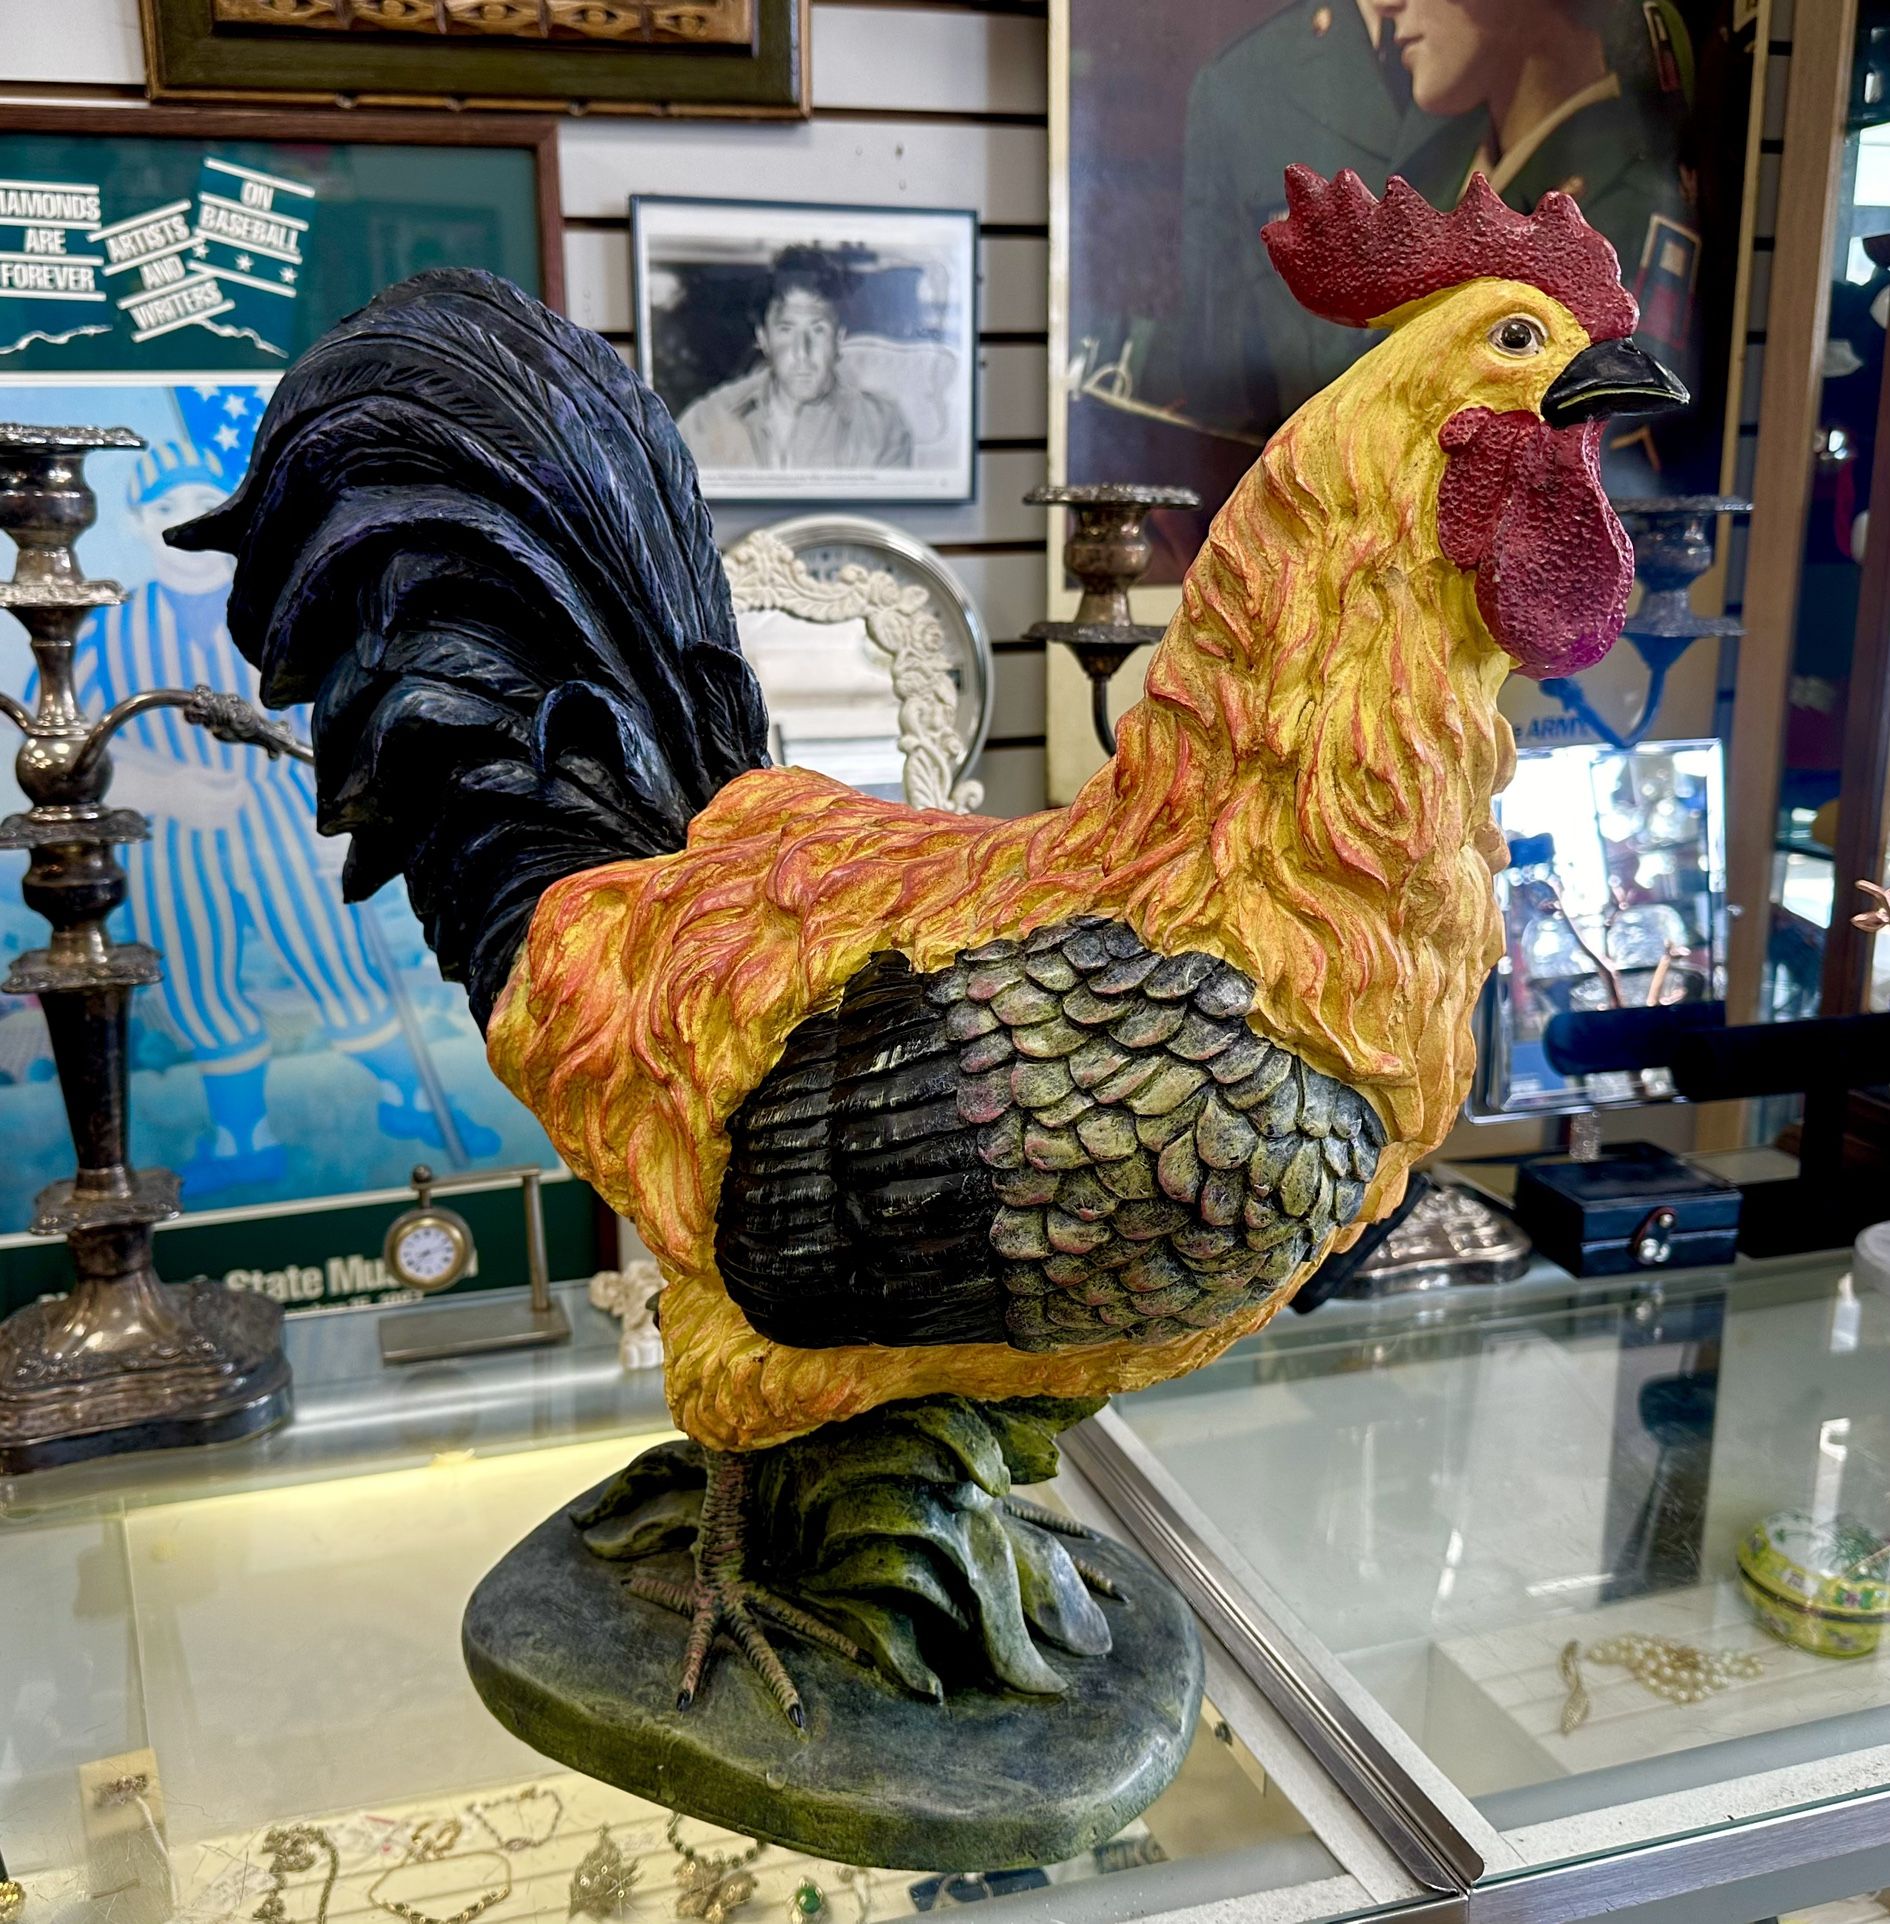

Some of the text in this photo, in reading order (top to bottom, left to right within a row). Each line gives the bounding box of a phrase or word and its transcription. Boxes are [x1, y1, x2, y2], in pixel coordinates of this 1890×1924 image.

[241, 181, 274, 210] ON
[24, 229, 67, 254] ARE
[105, 214, 190, 262] ARTISTS
[199, 204, 300, 254] BASEBALL
[1, 263, 95, 291] FOREVER
[139, 254, 185, 289] AND
[128, 279, 223, 330] WRITERS
[223, 1264, 325, 1304] State
